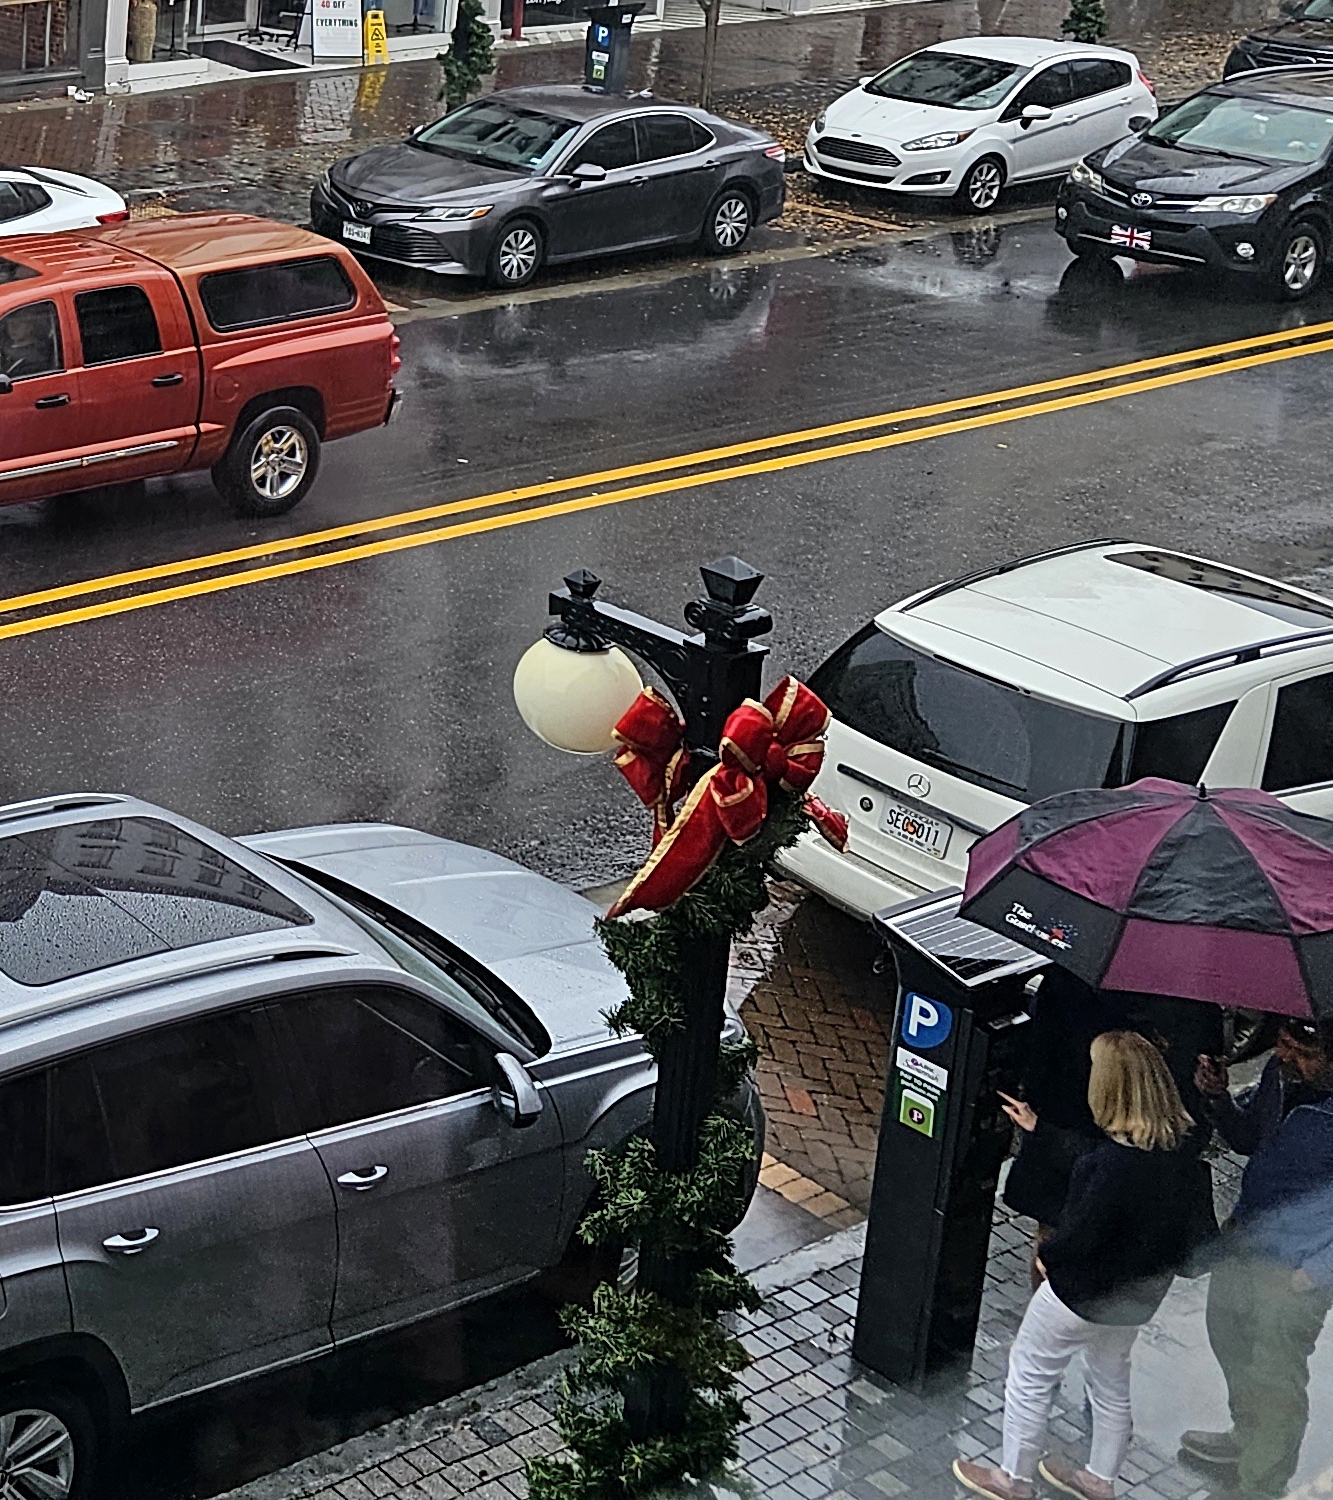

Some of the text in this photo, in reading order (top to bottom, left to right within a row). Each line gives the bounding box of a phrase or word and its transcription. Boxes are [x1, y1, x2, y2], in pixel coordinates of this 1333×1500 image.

[333, 0, 346, 9] OFF
[316, 18, 358, 27] EVERYTHING
[1012, 902, 1033, 920] The
[908, 995, 939, 1037] P
